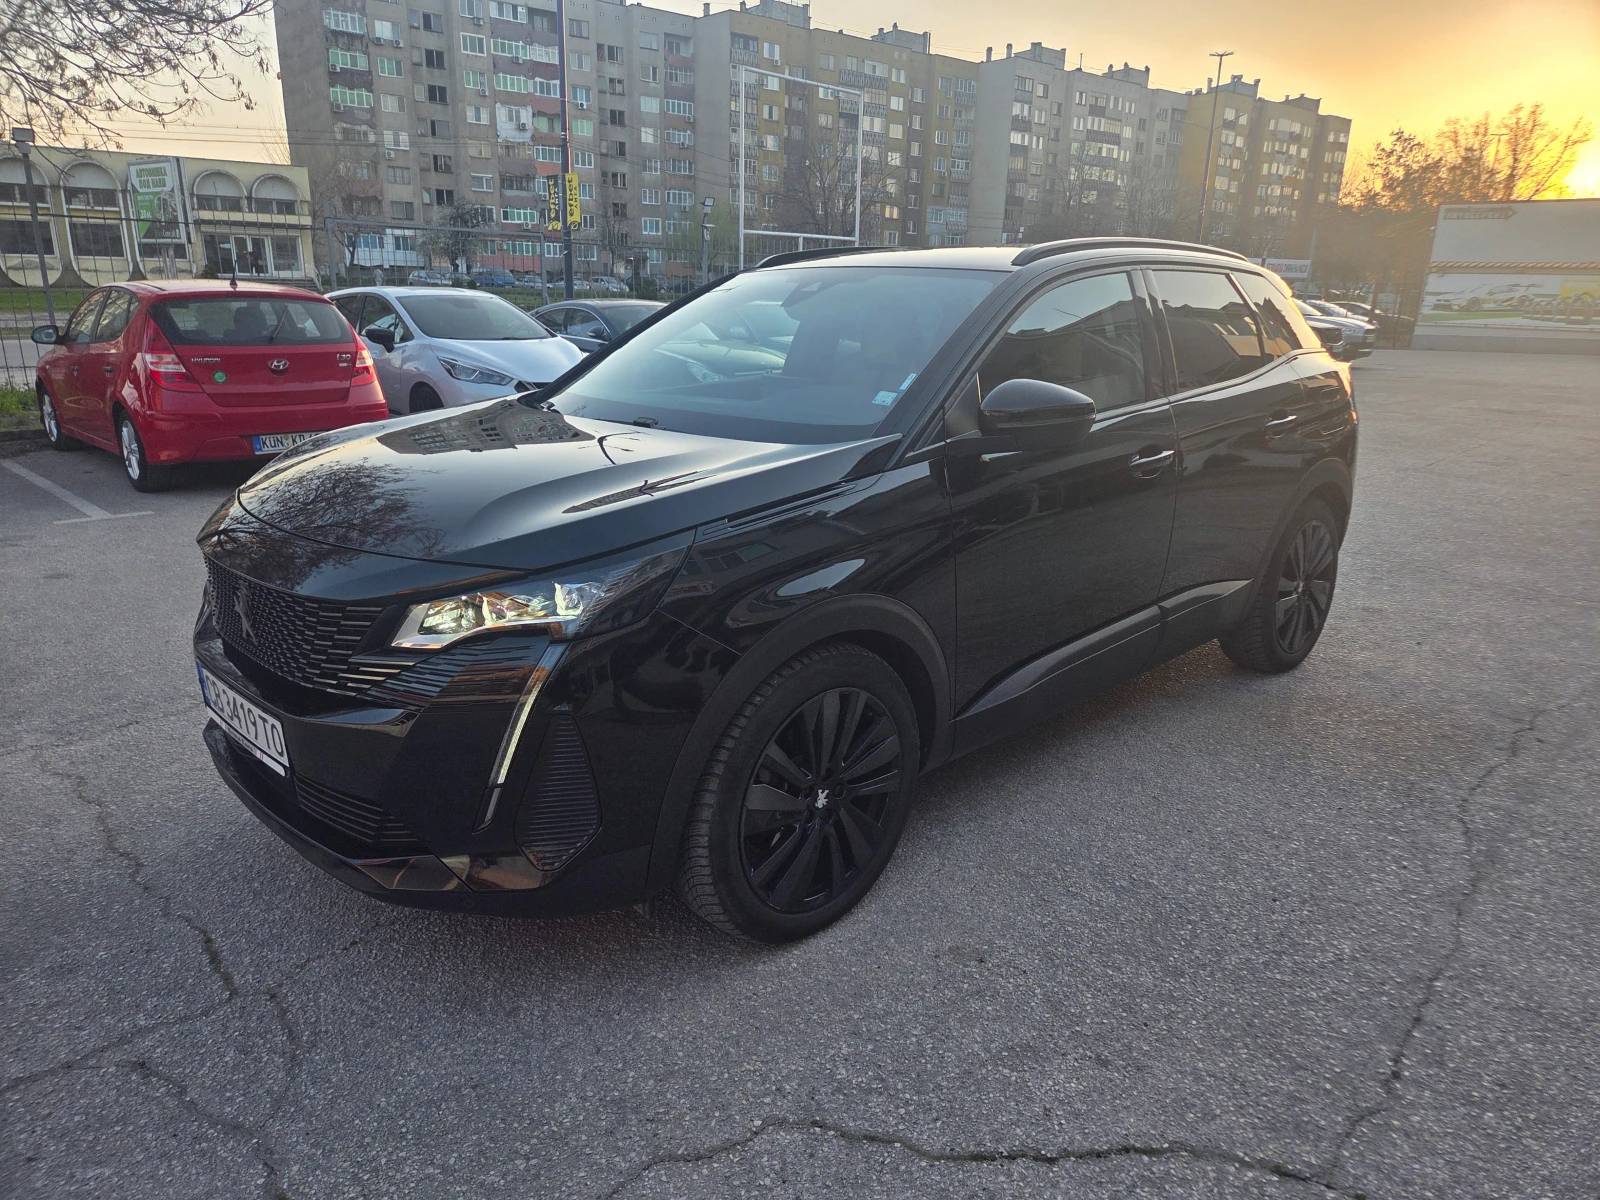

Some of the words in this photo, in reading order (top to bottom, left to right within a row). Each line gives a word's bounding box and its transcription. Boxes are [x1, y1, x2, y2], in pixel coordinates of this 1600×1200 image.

[138, 178, 152, 190] ПОД
[567, 176, 575, 217] efbet
[261, 435, 284, 449] KÜN
